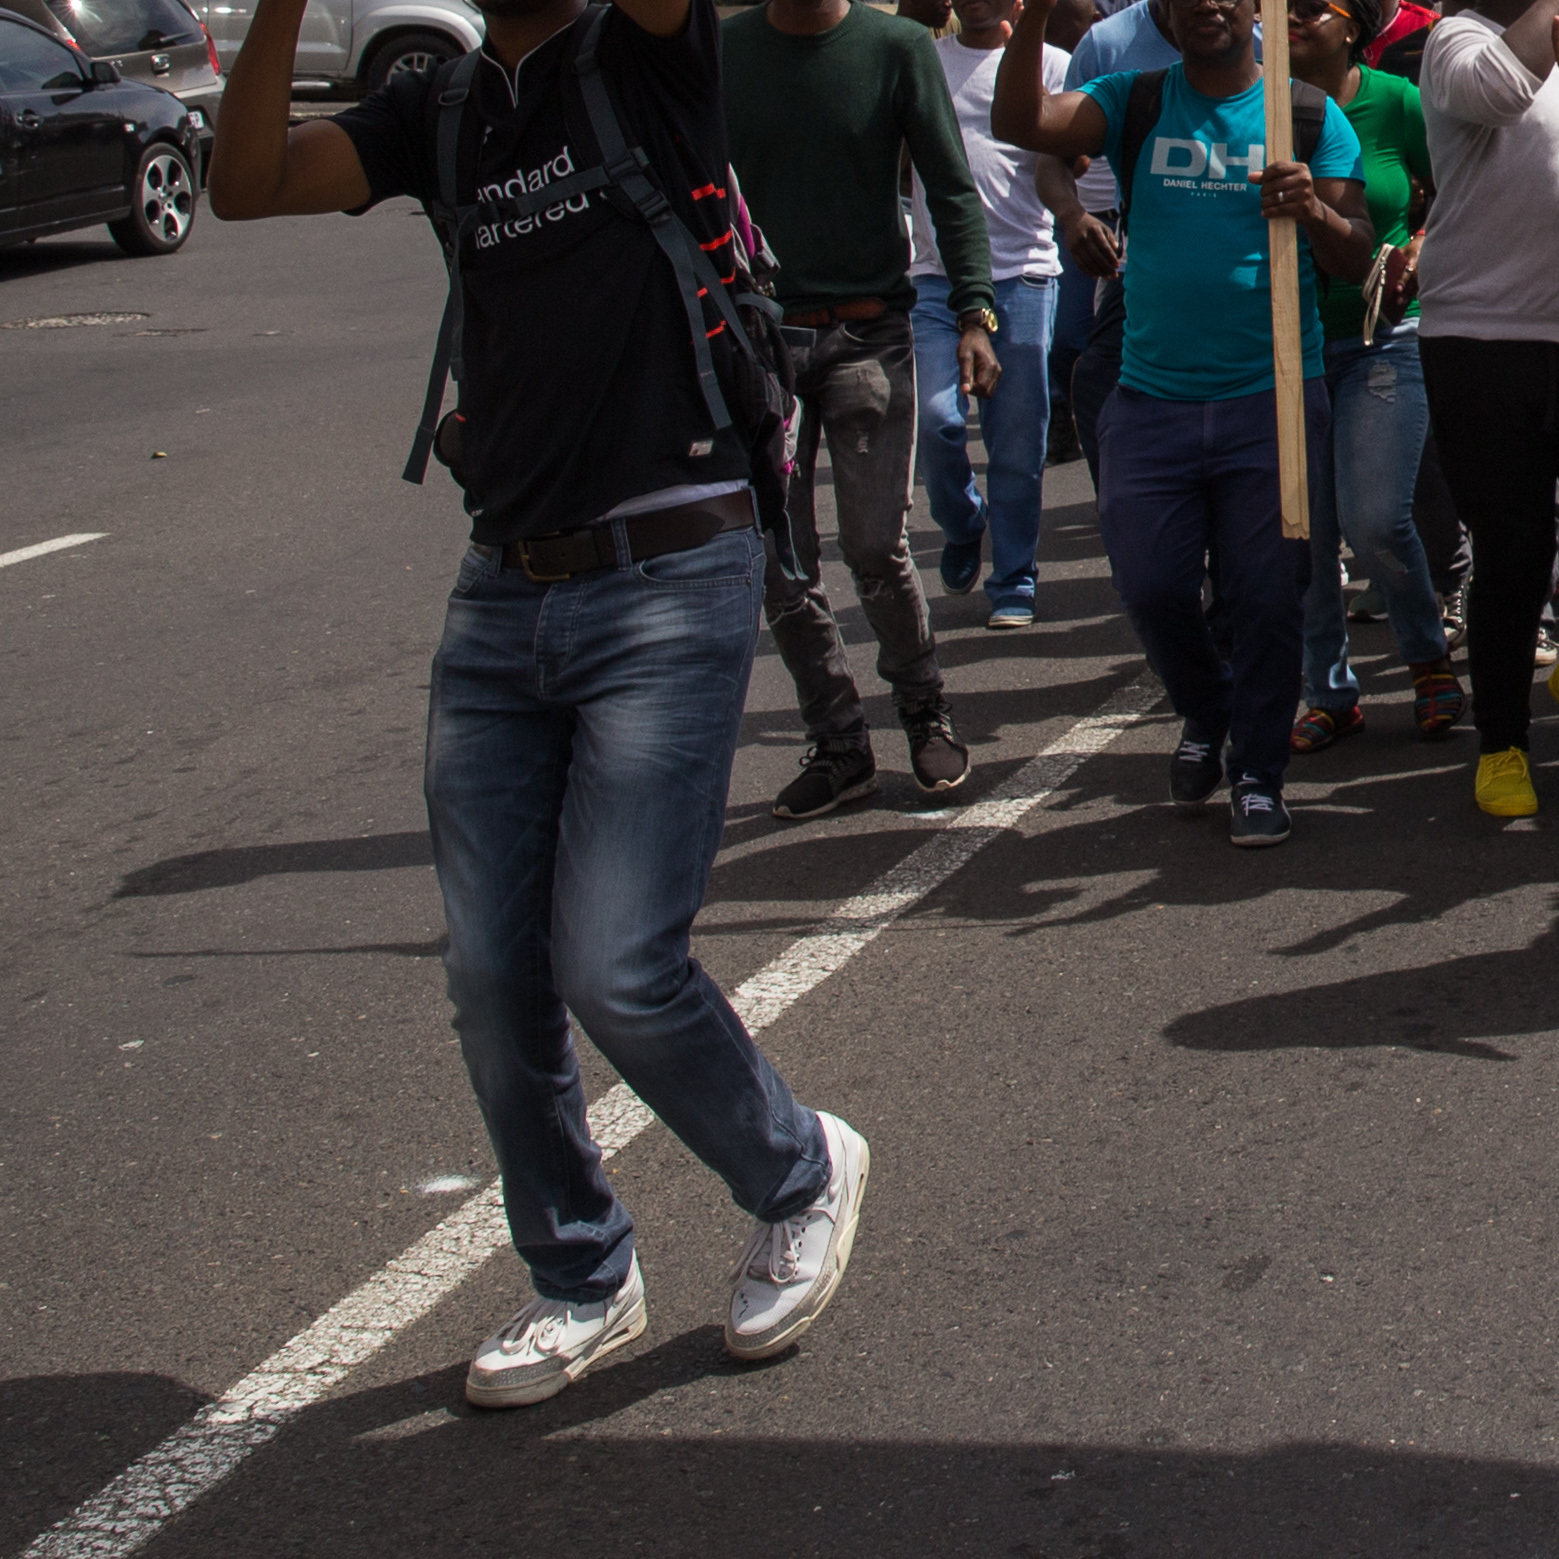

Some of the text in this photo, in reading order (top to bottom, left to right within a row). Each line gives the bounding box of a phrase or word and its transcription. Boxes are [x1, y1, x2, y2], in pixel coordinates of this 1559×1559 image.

[1150, 136, 1265, 180] DH
[1163, 178, 1248, 192] DANIEL HECHTER
